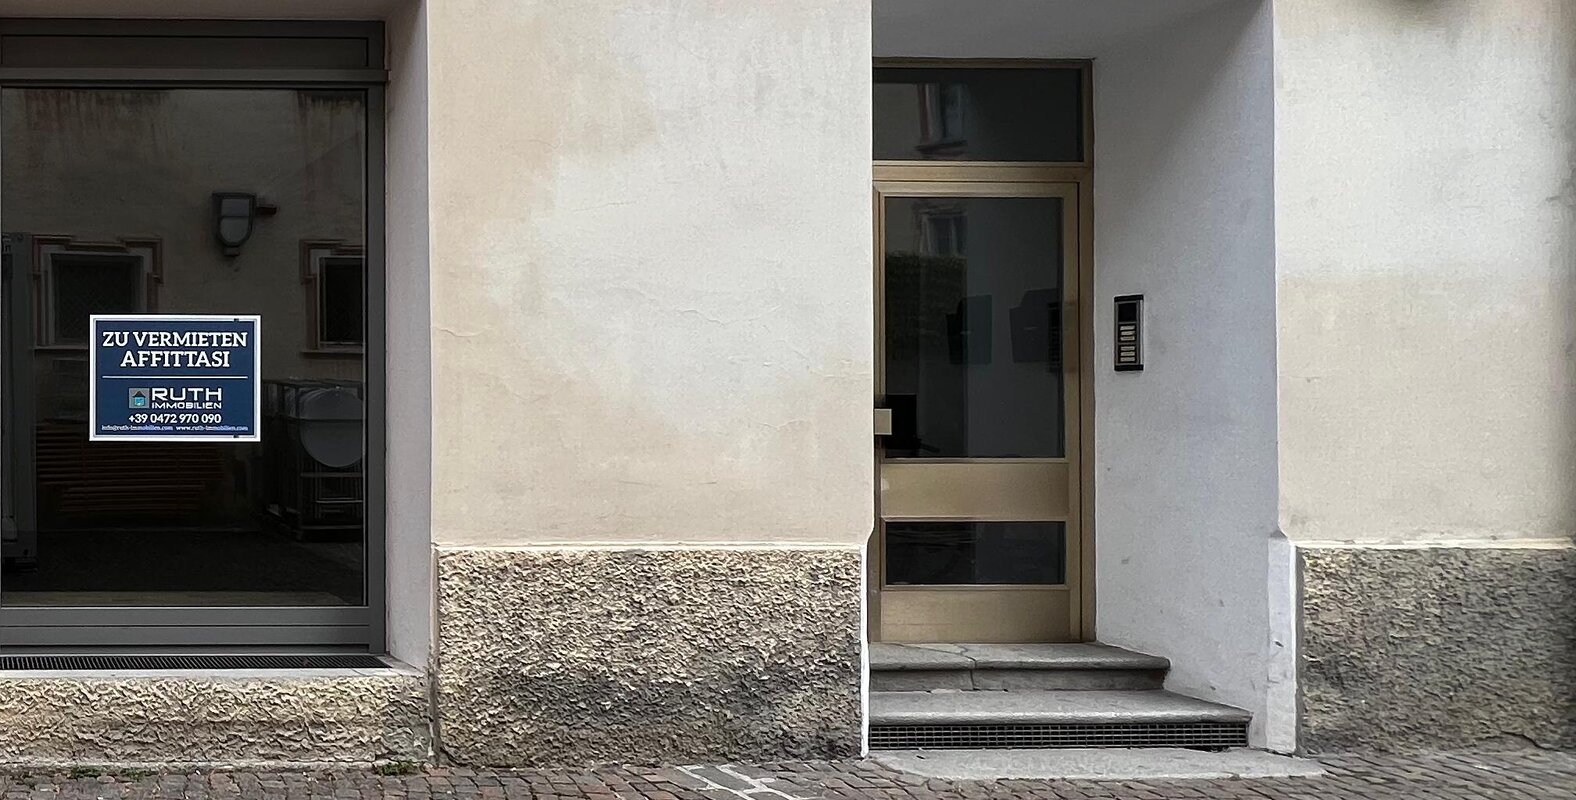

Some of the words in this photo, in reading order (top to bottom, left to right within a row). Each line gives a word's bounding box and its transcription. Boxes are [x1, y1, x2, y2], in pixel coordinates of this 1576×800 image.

[102, 331, 130, 347] ZU
[132, 331, 249, 347] VERMIETEN
[120, 350, 231, 367] AFFITTASI
[151, 387, 222, 401] RUTH
[128, 413, 148, 423] +39
[150, 413, 178, 423] 0472
[179, 413, 199, 423] 970
[201, 413, 222, 423] 090
